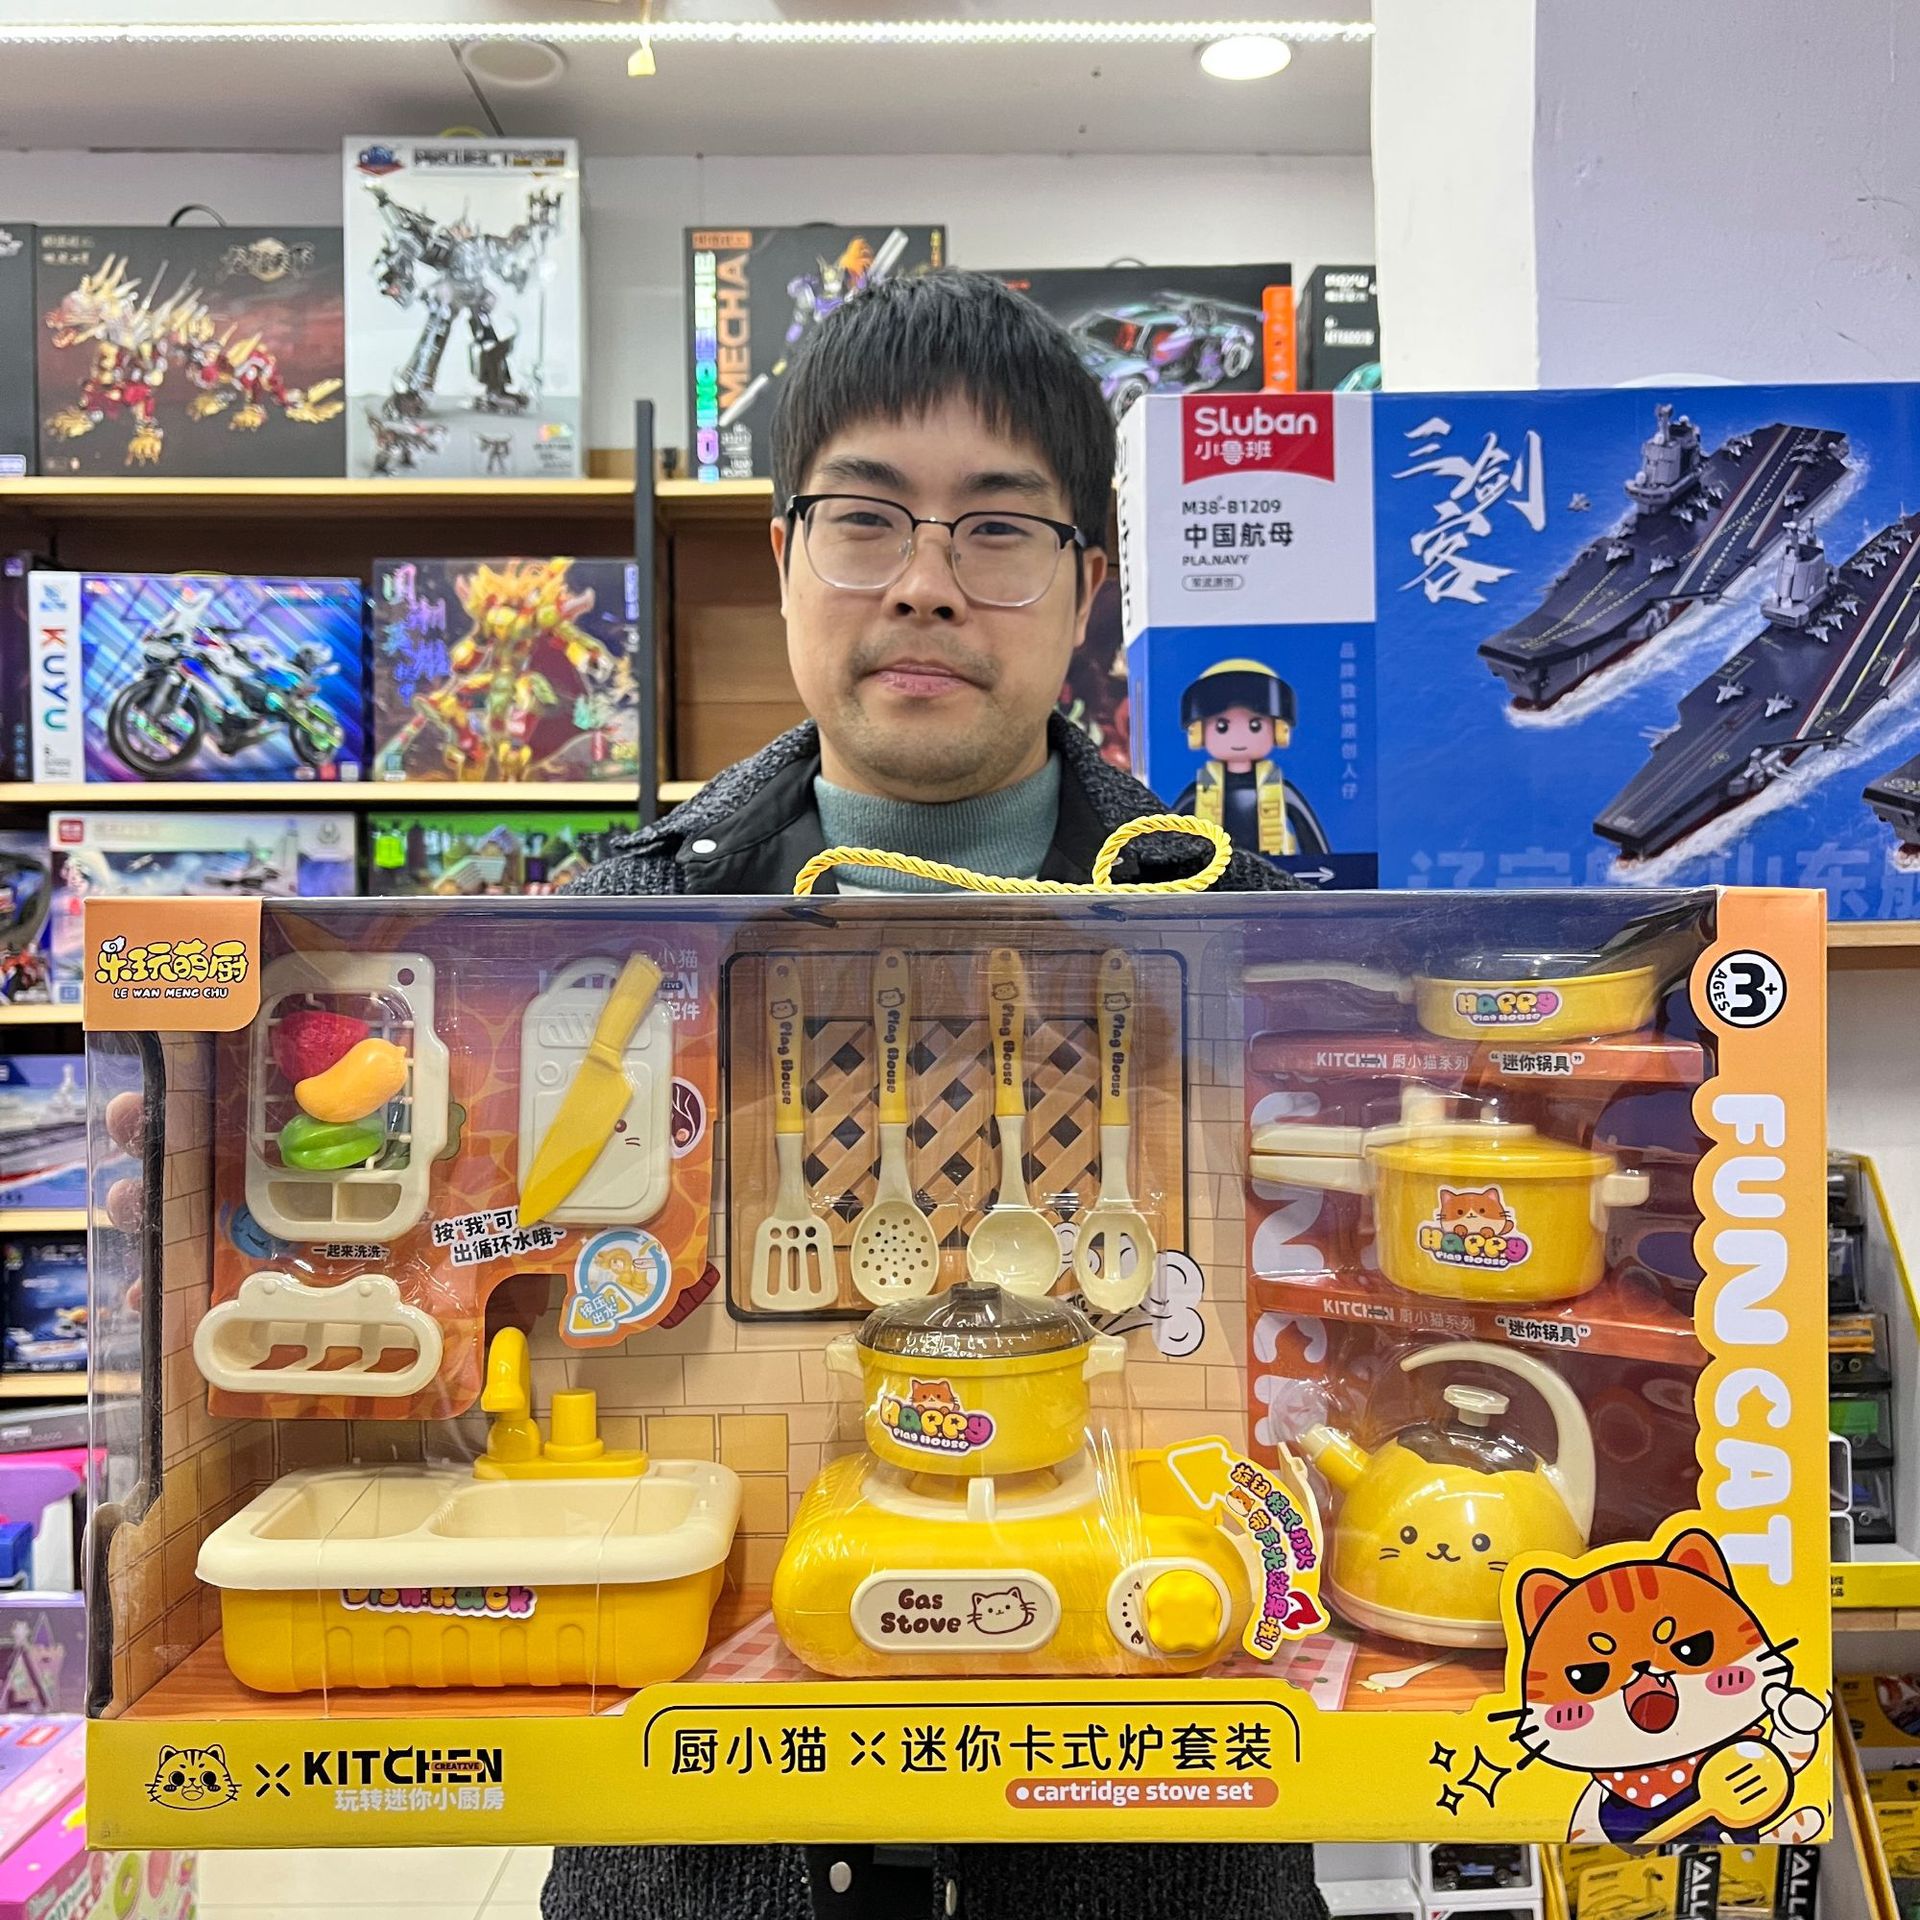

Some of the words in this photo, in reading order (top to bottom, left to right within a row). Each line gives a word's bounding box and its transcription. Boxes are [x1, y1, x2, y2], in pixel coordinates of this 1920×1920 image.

[718, 254, 749, 410] MECHA
[1194, 407, 1318, 437] Sluban
[1194, 441, 1272, 465] 小鲁班
[1182, 500, 1283, 515] M38-B1209
[1184, 522, 1293, 548] 中国航母
[1182, 554, 1249, 567] PLA.NAVY
[41, 628, 69, 732] KUYU
[114, 988, 128, 998] LE
[132, 988, 160, 998] WAN
[165, 987, 200, 998] MENG
[203, 986, 229, 998] CHU
[1712, 968, 1731, 1012] AGES
[1730, 962, 1778, 1018] 3+
[884, 1010, 900, 1043] Play
[999, 1003, 1015, 1037] Play
[1109, 1014, 1125, 1048] Play
[777, 1021, 793, 1056] Play
[1392, 1053, 1469, 1071] 厨小猫系列
[434, 1209, 520, 1244] 按“我”可
[1712, 1093, 1788, 1345] FUN
[1399, 1309, 1476, 1332] 厨小猫系列
[893, 1427, 919, 1442] Play
[920, 1434, 970, 1450] House
[1714, 1367, 1792, 1585] CAT
[898, 1588, 943, 1611] Gas
[880, 1611, 962, 1635] Stove
[671, 1726, 829, 1776] 厨小猫
[899, 1722, 1274, 1774] 迷你卡式炉套装
[303, 1745, 503, 1786] KITCHEN
[433, 1762, 481, 1771] CREATIVE
[334, 1786, 505, 1813] 玩转迷你小厨房
[1032, 1780, 1140, 1806] cartridge
[1145, 1782, 1211, 1802] stove
[1215, 1783, 1254, 1802] set
